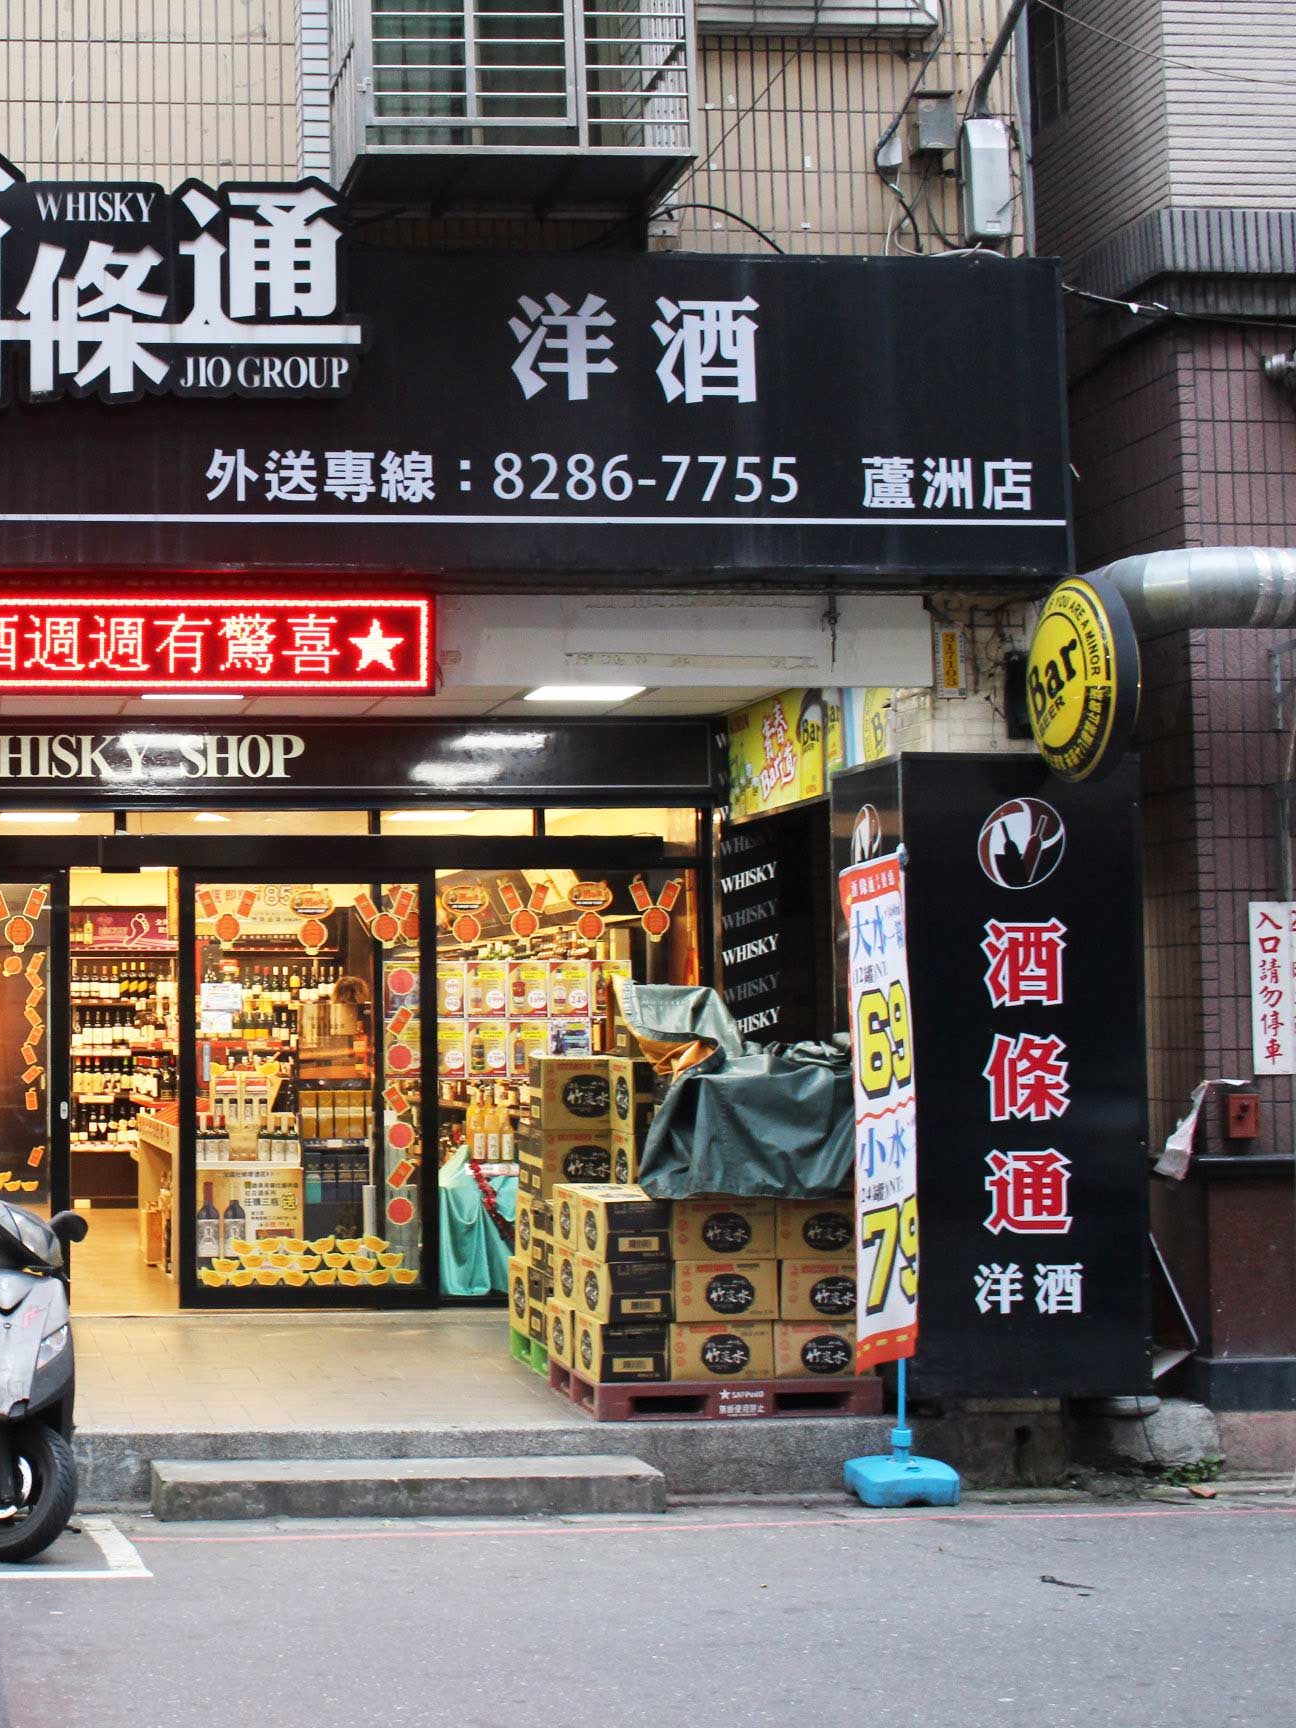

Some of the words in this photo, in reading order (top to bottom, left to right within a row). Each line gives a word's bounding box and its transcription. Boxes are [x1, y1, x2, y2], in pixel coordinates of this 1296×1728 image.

[36, 191, 155, 223] WHISKY
[508, 292, 759, 404] 洋酒
[180, 356, 231, 389] JIO
[237, 356, 349, 389] GROUP
[861, 455, 1033, 511] 蘆洲店
[1068, 600, 1085, 620] ARE
[1081, 619, 1090, 631] A
[1085, 631, 1101, 677] MINOR
[1029, 638, 1077, 724] Bar
[1039, 696, 1066, 737] BEER
[177, 733, 304, 779] SHOP
[721, 861, 778, 894] WHISKY
[722, 900, 779, 931] WHISKY
[722, 933, 780, 967] WHISKY
[723, 972, 781, 1004] WHISKY
[1256, 911, 1285, 1066] 入口請勿停車
[737, 1005, 781, 1035] HISKY
[980, 918, 1072, 1236] 酒條通
[859, 1120, 906, 1178] 小水
[974, 1262, 1083, 1314] 洋酒
